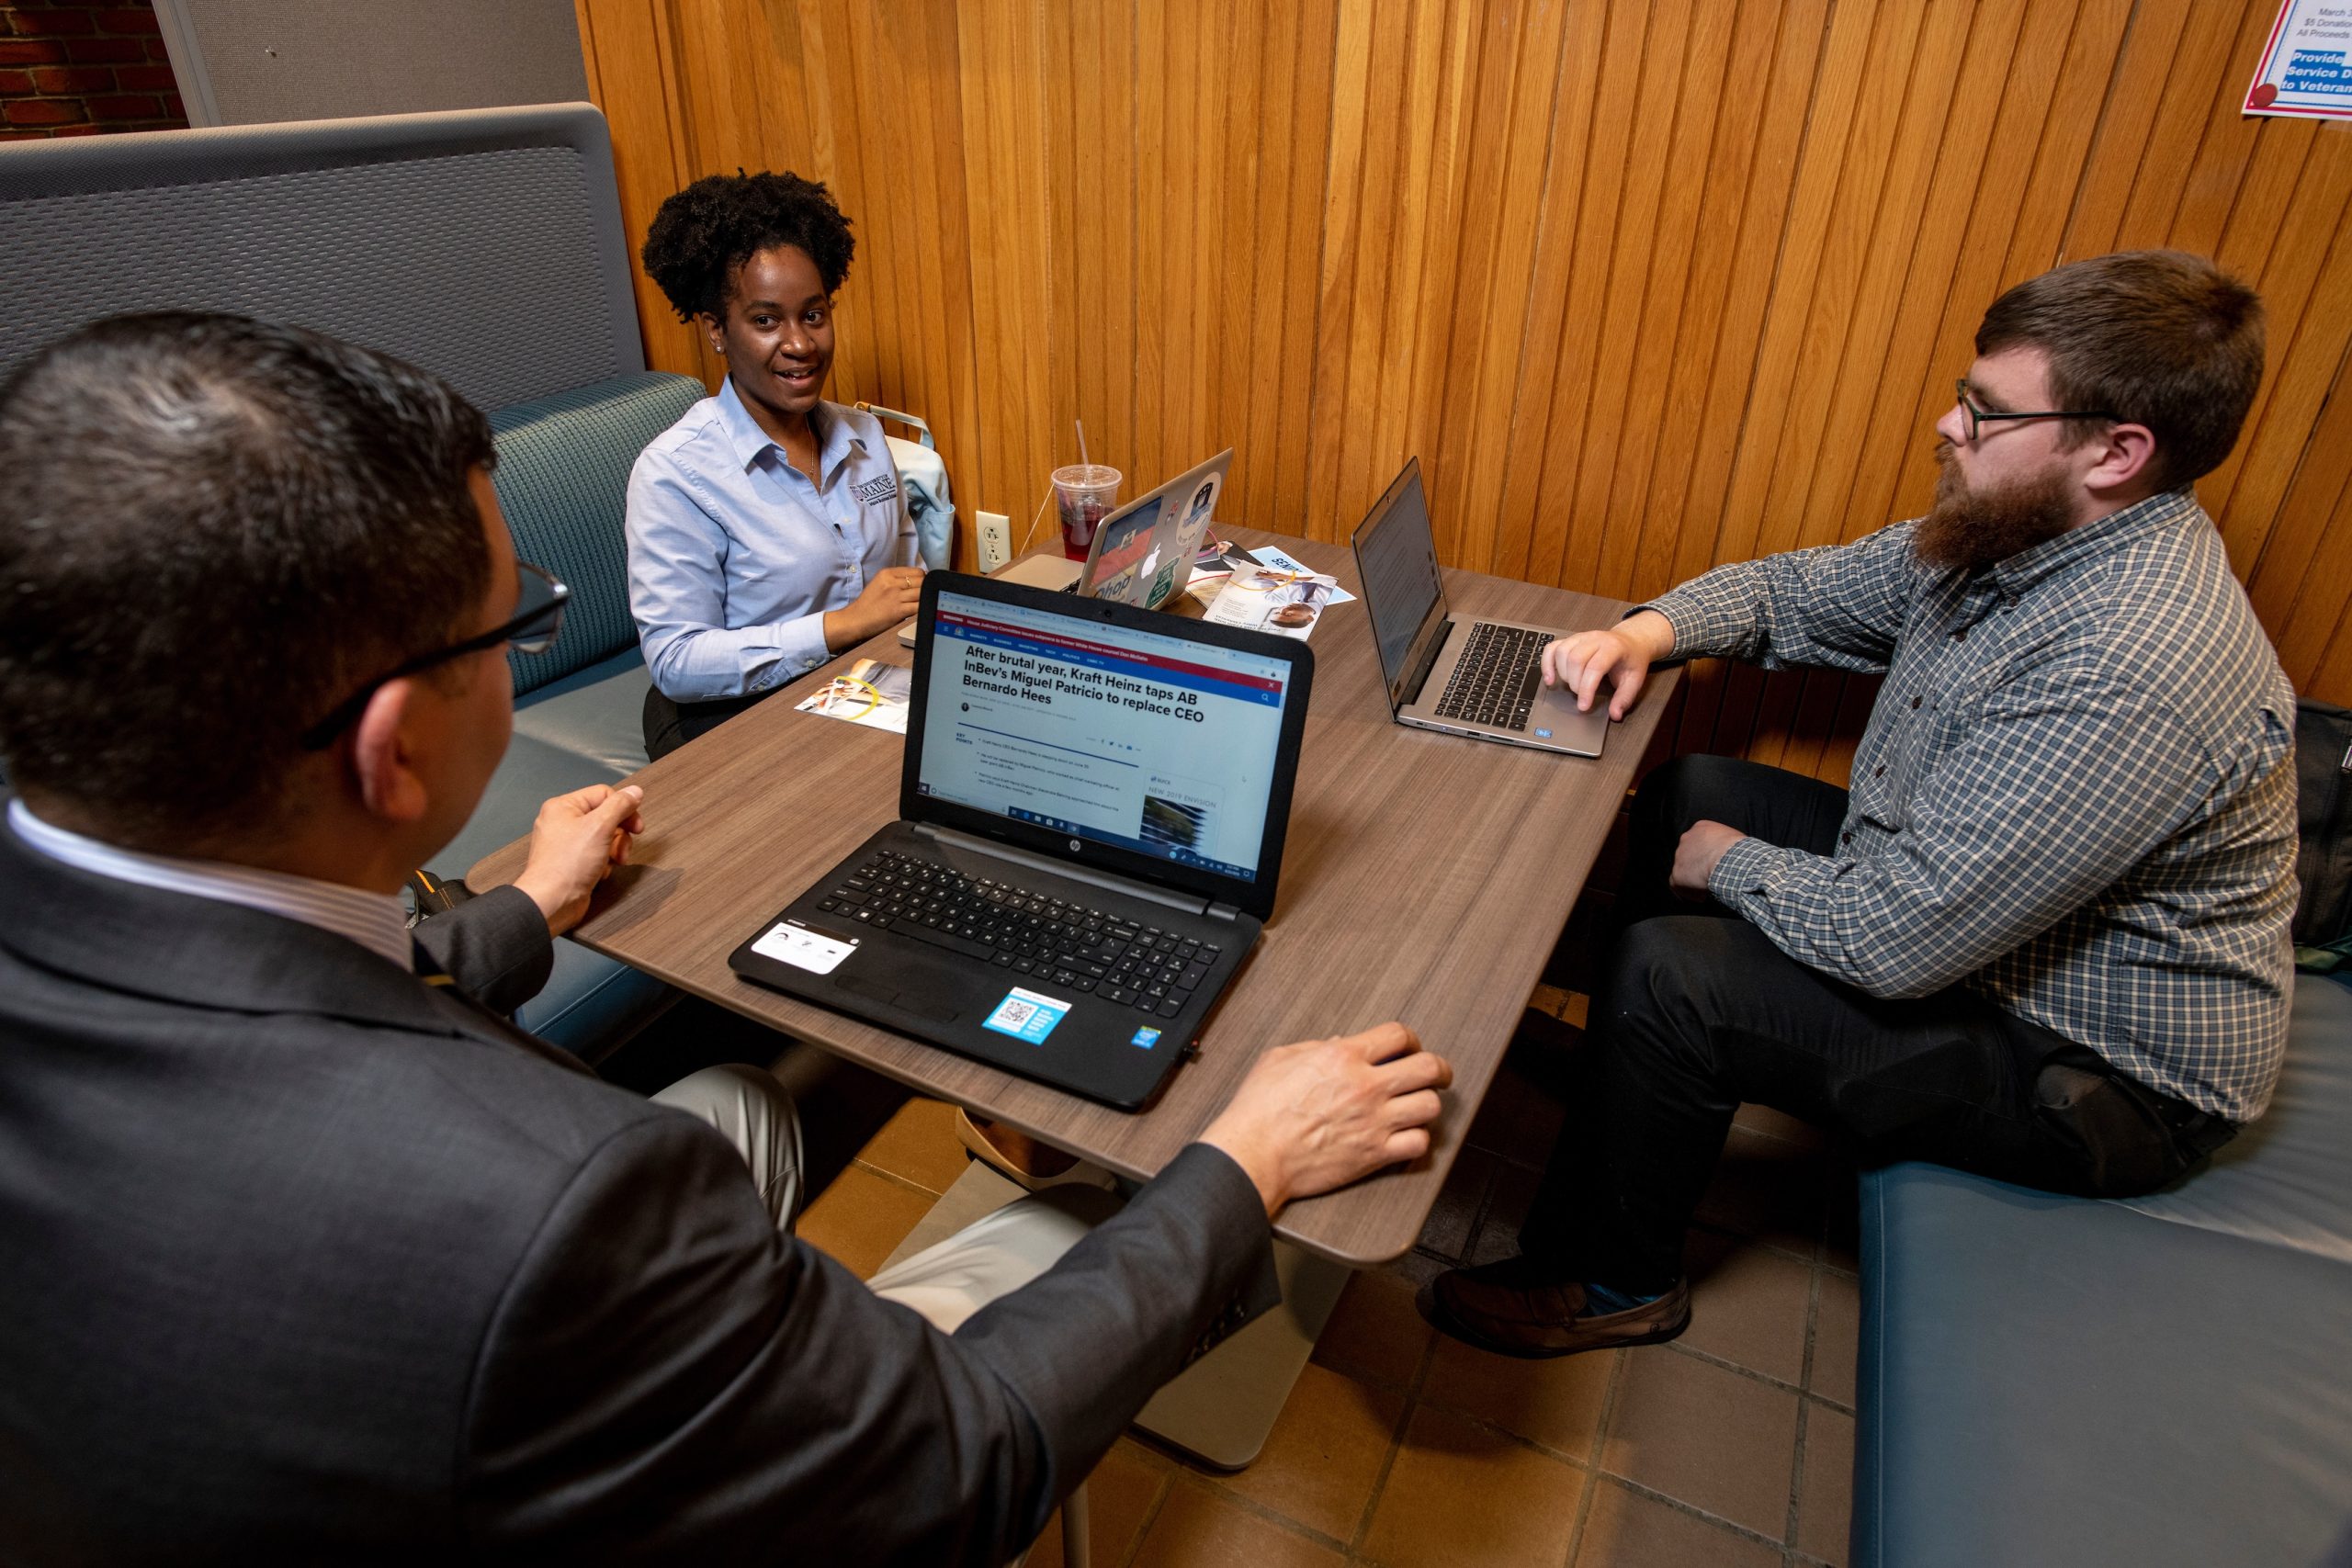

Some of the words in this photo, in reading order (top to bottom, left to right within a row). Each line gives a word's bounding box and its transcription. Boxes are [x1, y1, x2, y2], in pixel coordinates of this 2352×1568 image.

[2310, 29, 2350, 38] Proceeds
[2293, 52, 2343, 64] Provide
[2287, 66, 2338, 78] Service
[2281, 80, 2295, 90] to
[860, 478, 896, 498] MAINE
[966, 645, 996, 660] After
[999, 652, 1035, 669] brutal
[1038, 663, 1066, 678] year,
[1071, 667, 1102, 684] Kraft
[1105, 676, 1142, 693] Heinz
[1146, 685, 1174, 700] taps
[1177, 692, 1198, 705] AB
[963, 675, 1018, 696] Bernardo
[1021, 688, 1052, 704] Hees
[1011, 671, 1052, 689] Miguel
[1056, 680, 1103, 700] Patricio
[1106, 692, 1119, 704] to
[1123, 697, 1171, 715] replace
[1174, 707, 1204, 722] CEO
[1149, 786, 1165, 795] NEW
[1167, 791, 1182, 800] 2019
[1184, 796, 1217, 808] ENVISION
[1069, 840, 1080, 852] hp
